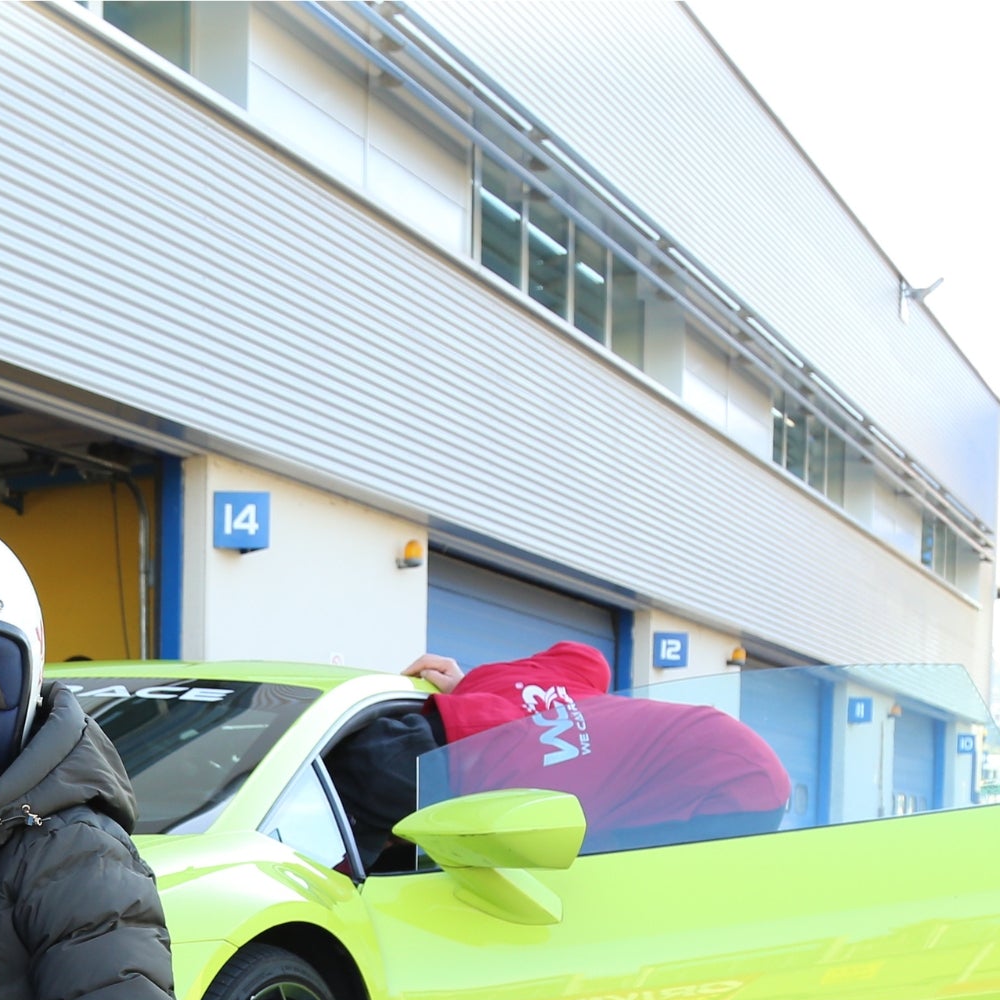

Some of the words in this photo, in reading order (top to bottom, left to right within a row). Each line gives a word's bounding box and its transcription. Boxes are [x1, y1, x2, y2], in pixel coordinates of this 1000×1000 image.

[224, 503, 259, 535] 14
[660, 638, 681, 660] 12
[579, 733, 592, 756] WE
